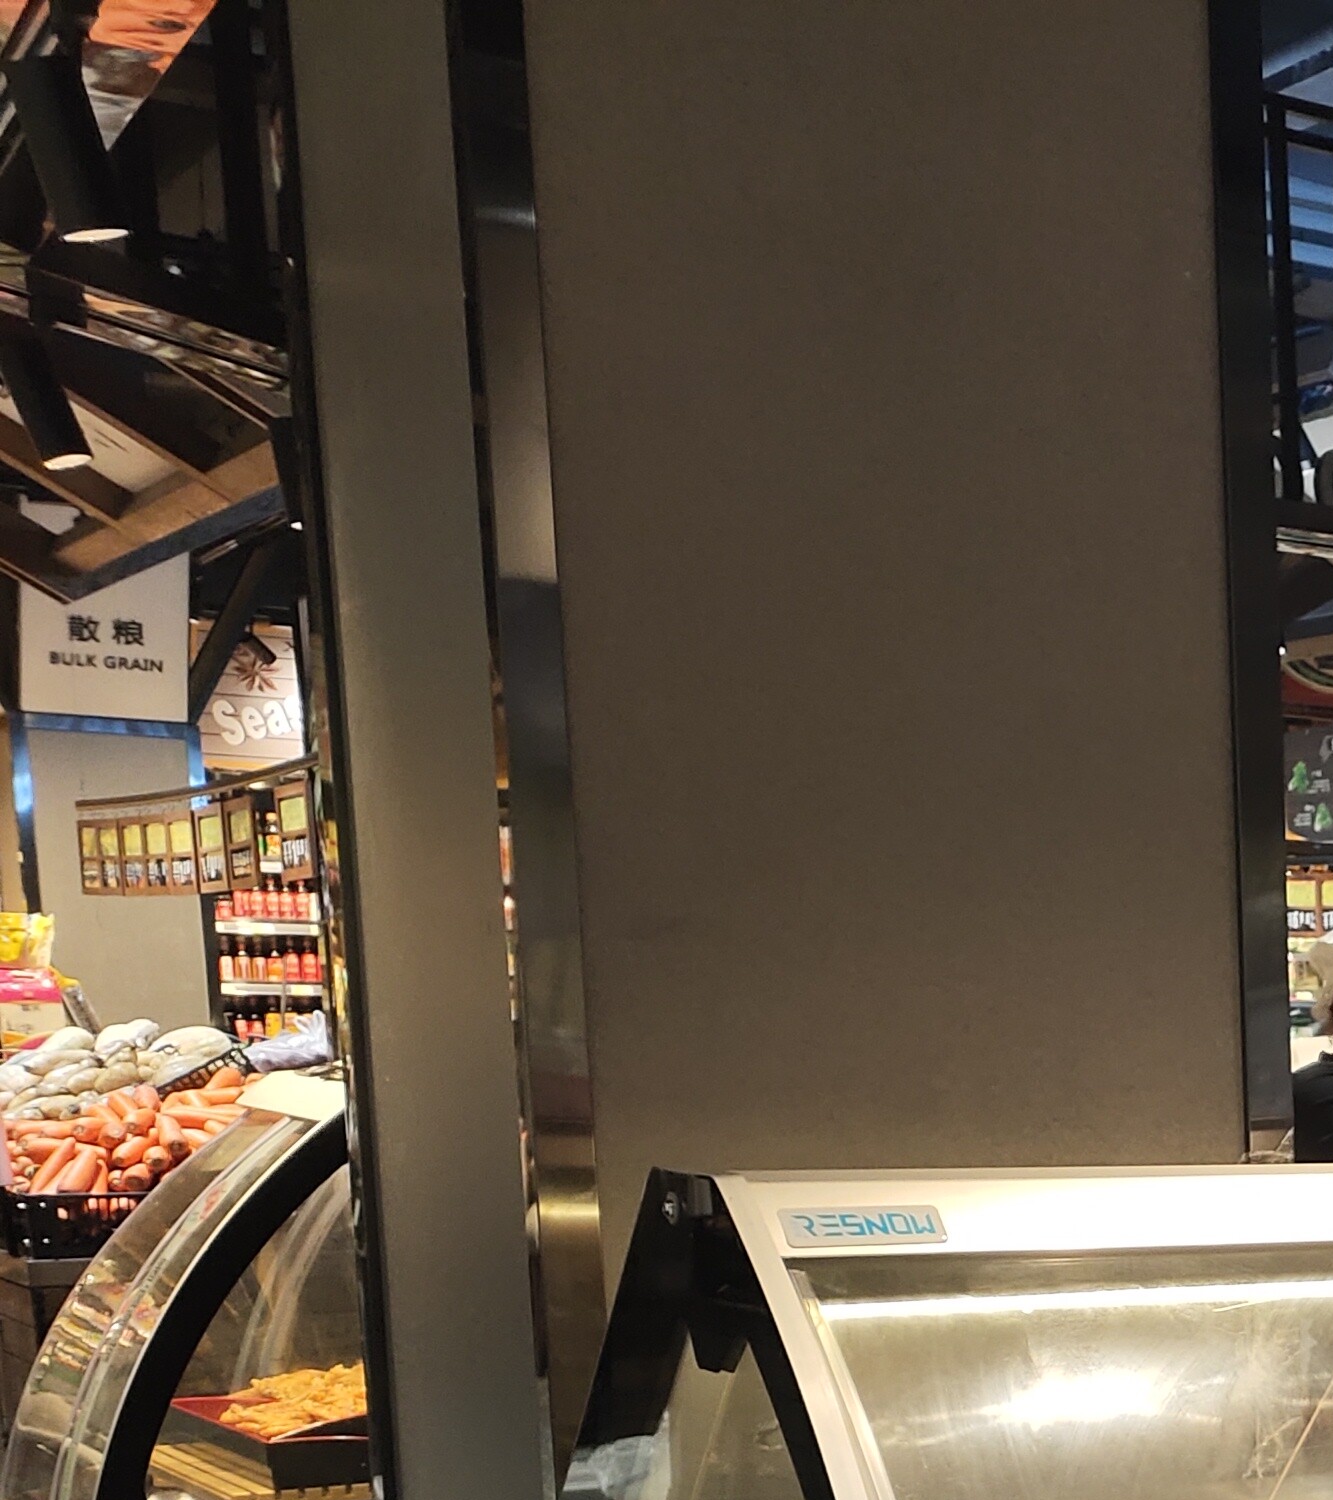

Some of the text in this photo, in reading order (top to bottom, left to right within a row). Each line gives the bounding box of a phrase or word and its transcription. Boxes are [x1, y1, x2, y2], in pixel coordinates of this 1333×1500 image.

[49, 651, 163, 673] BULK GRAIN
[791, 1212, 937, 1237] RESNOW
